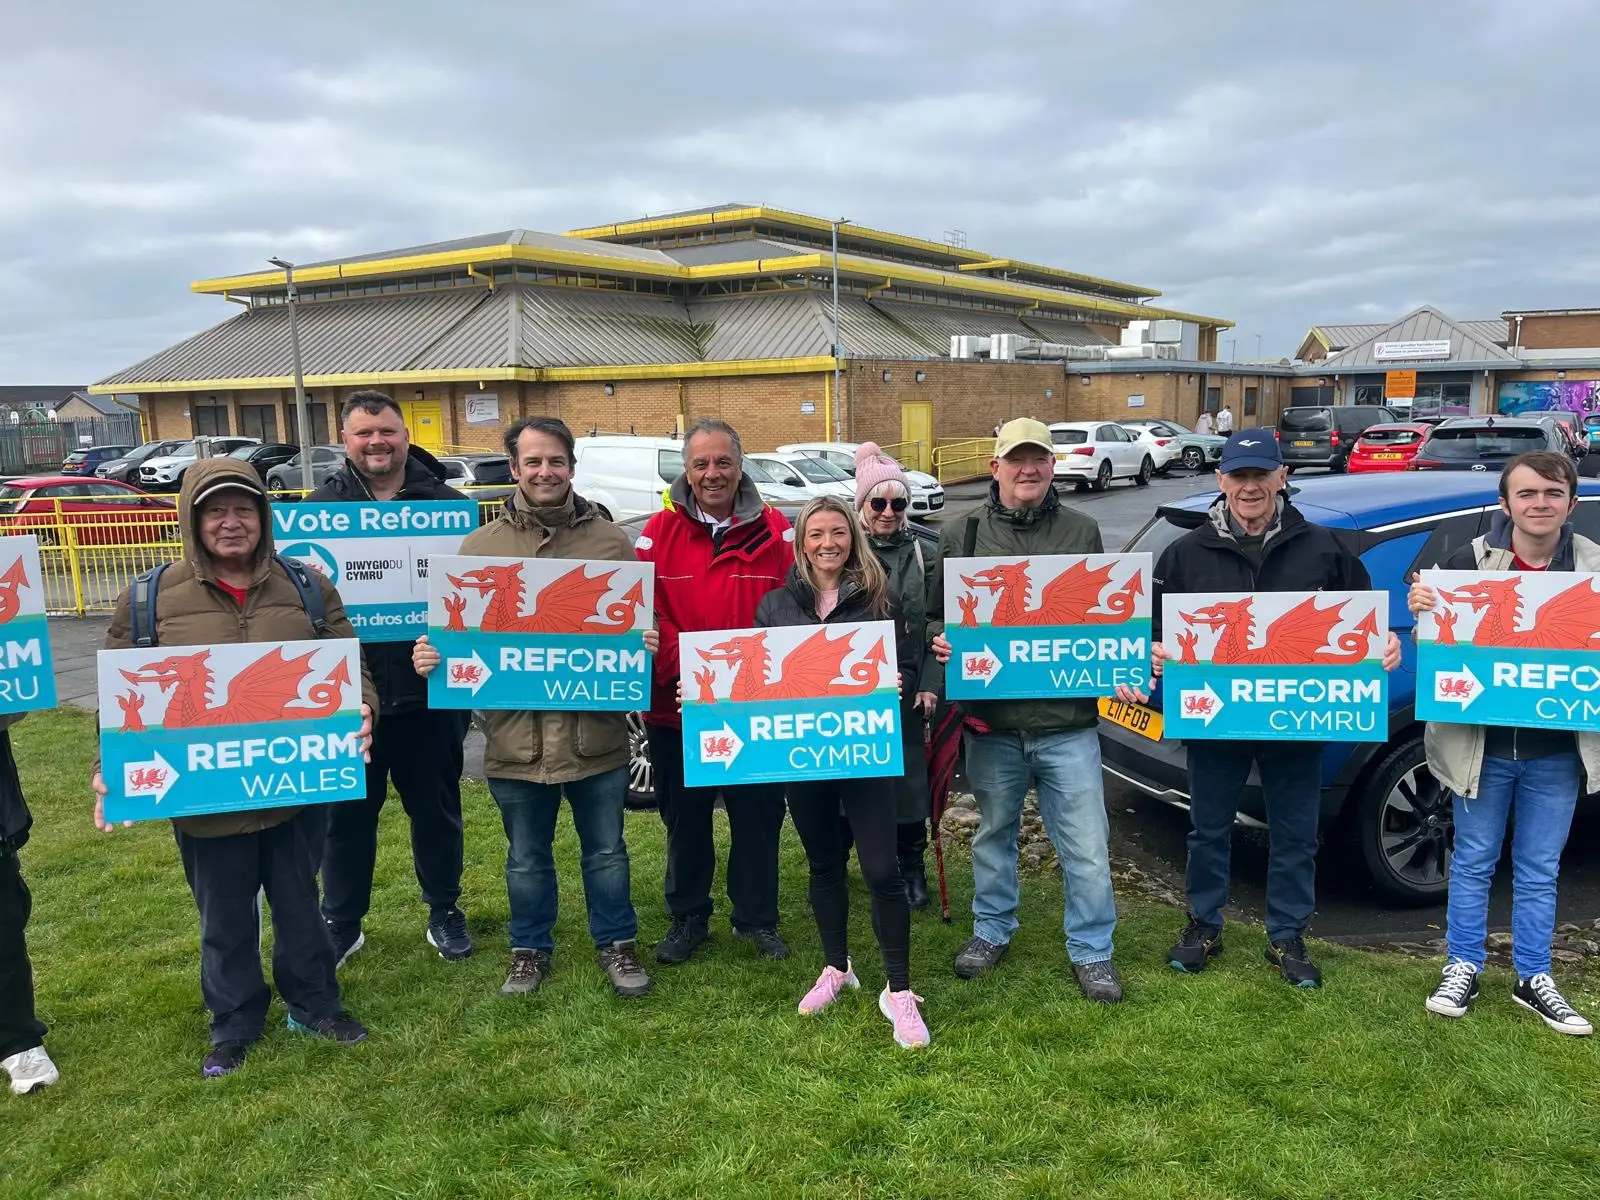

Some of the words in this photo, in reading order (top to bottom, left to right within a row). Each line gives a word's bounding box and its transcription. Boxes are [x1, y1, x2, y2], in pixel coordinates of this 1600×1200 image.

[273, 508, 349, 533] Vote
[360, 505, 471, 531] Reform
[346, 559, 403, 570] DIWYGIODU
[346, 570, 383, 581] CYMRU
[369, 612, 402, 626] dros
[499, 647, 645, 673] REFORM
[1009, 637, 1146, 663] REFORM
[543, 679, 644, 701] WALES
[1050, 667, 1144, 688] WALES
[1231, 678, 1381, 703] REFORM
[750, 708, 895, 742] REFORM
[1122, 704, 1150, 731] FOB
[1269, 709, 1376, 731] CYMRU
[187, 731, 358, 772] REFORM
[789, 742, 892, 769] CYMRU
[240, 766, 358, 798] WALES
